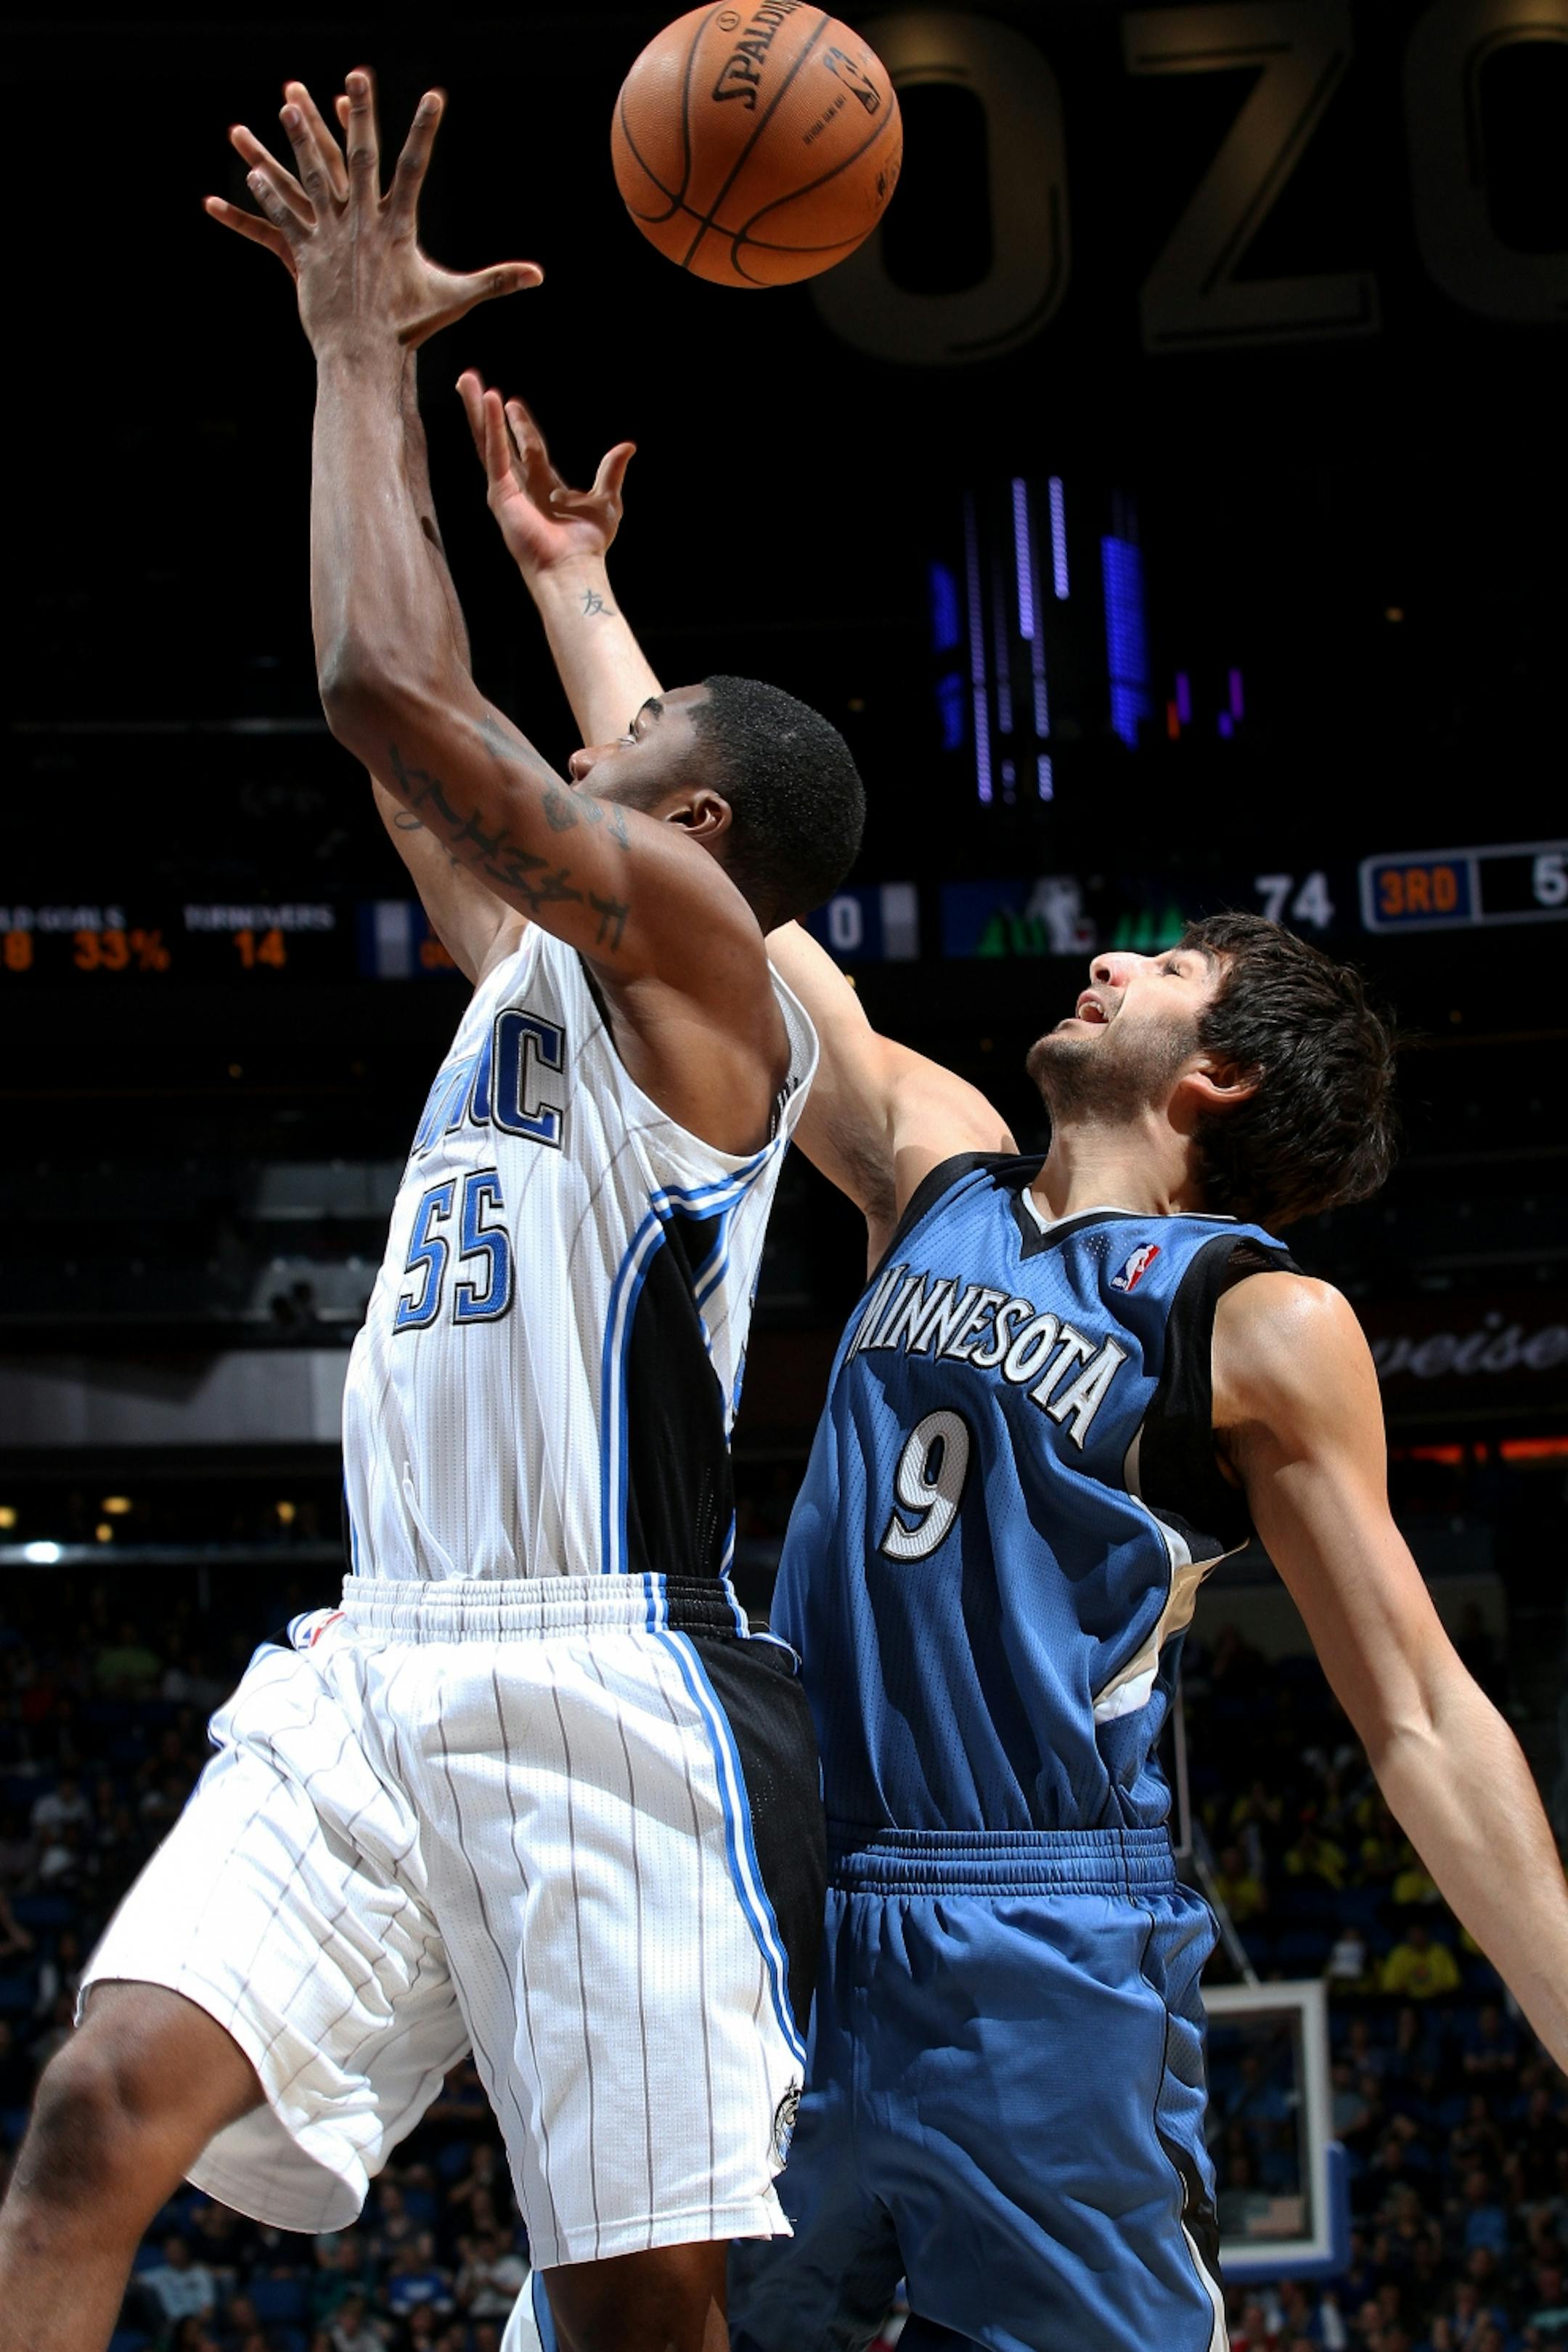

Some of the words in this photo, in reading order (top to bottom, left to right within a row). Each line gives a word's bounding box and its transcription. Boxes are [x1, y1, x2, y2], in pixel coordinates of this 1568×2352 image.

[1254, 872, 1334, 928] 74
[1381, 865, 1458, 916] 3RD
[74, 928, 171, 971] 33%
[234, 929, 286, 970] 14
[392, 1167, 514, 1336] 55
[844, 1263, 1128, 1450] MINNESOTA
[881, 1410, 970, 1565] 9
